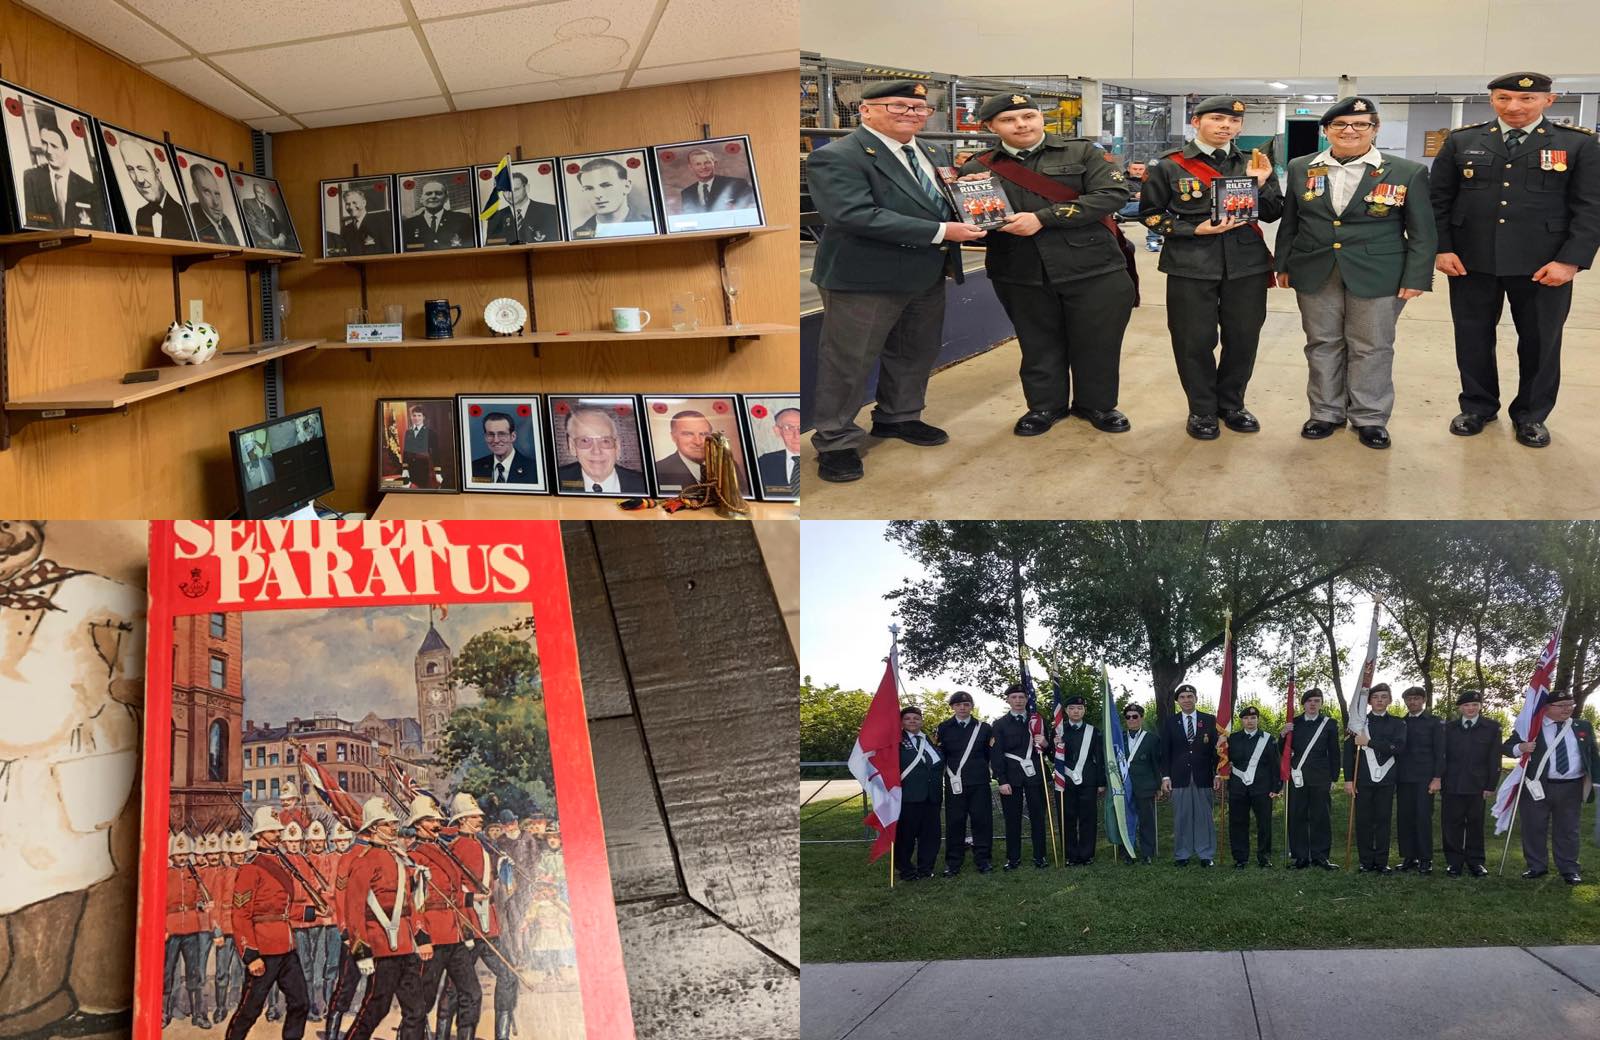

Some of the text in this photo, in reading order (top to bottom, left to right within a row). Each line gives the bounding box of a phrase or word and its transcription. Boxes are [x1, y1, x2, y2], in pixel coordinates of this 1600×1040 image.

[959, 183, 993, 193] RILEYS
[173, 520, 449, 560] SEMPER
[217, 543, 530, 604] PARATUS
